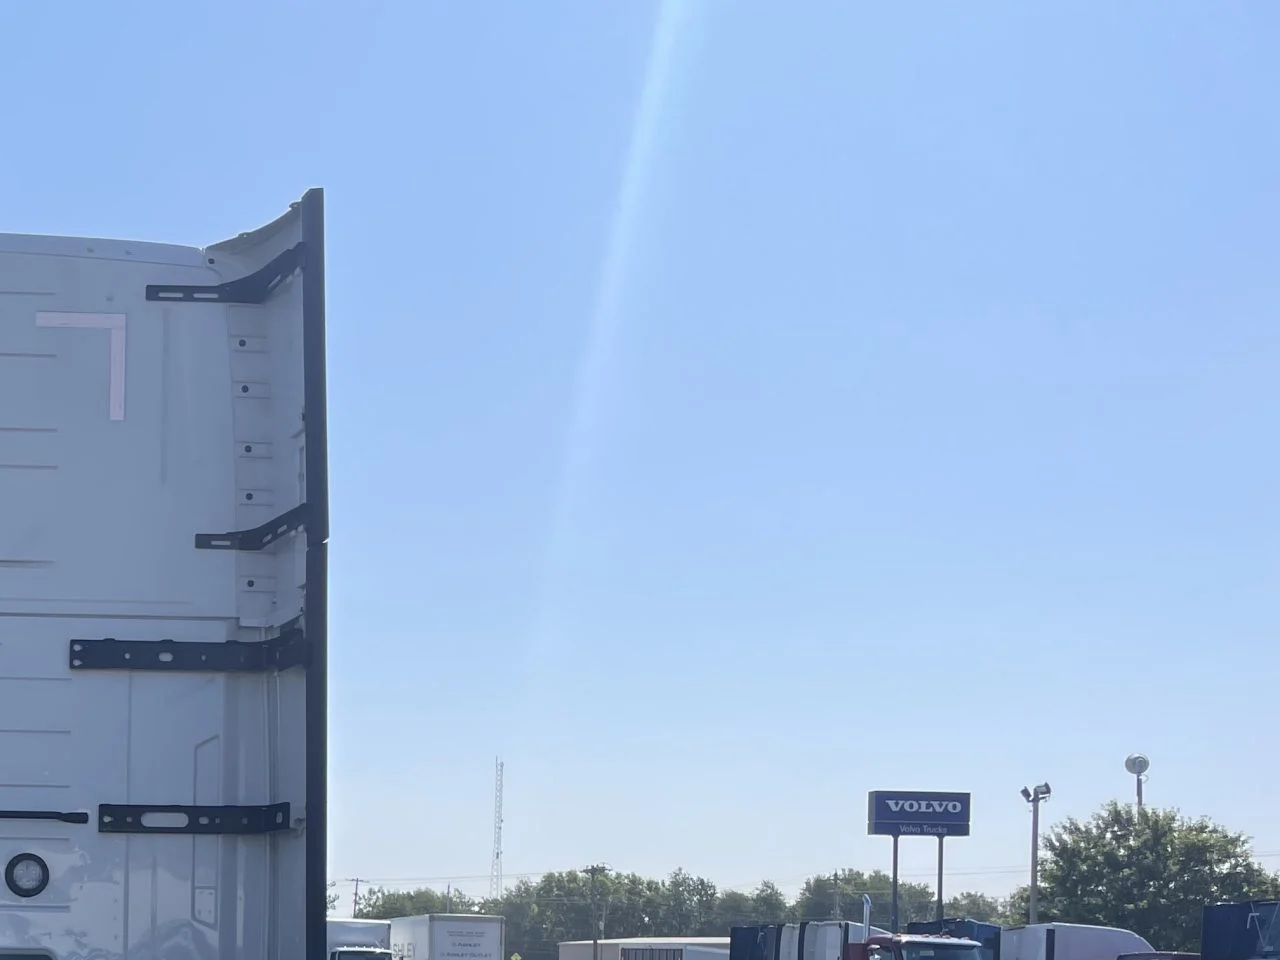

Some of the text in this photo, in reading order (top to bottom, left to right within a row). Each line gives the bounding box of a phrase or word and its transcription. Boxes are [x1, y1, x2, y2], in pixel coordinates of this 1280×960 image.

[885, 799, 962, 813] VOLVO
[899, 824, 948, 834] Volvo Trucks
[391, 942, 417, 959] SHLEY
